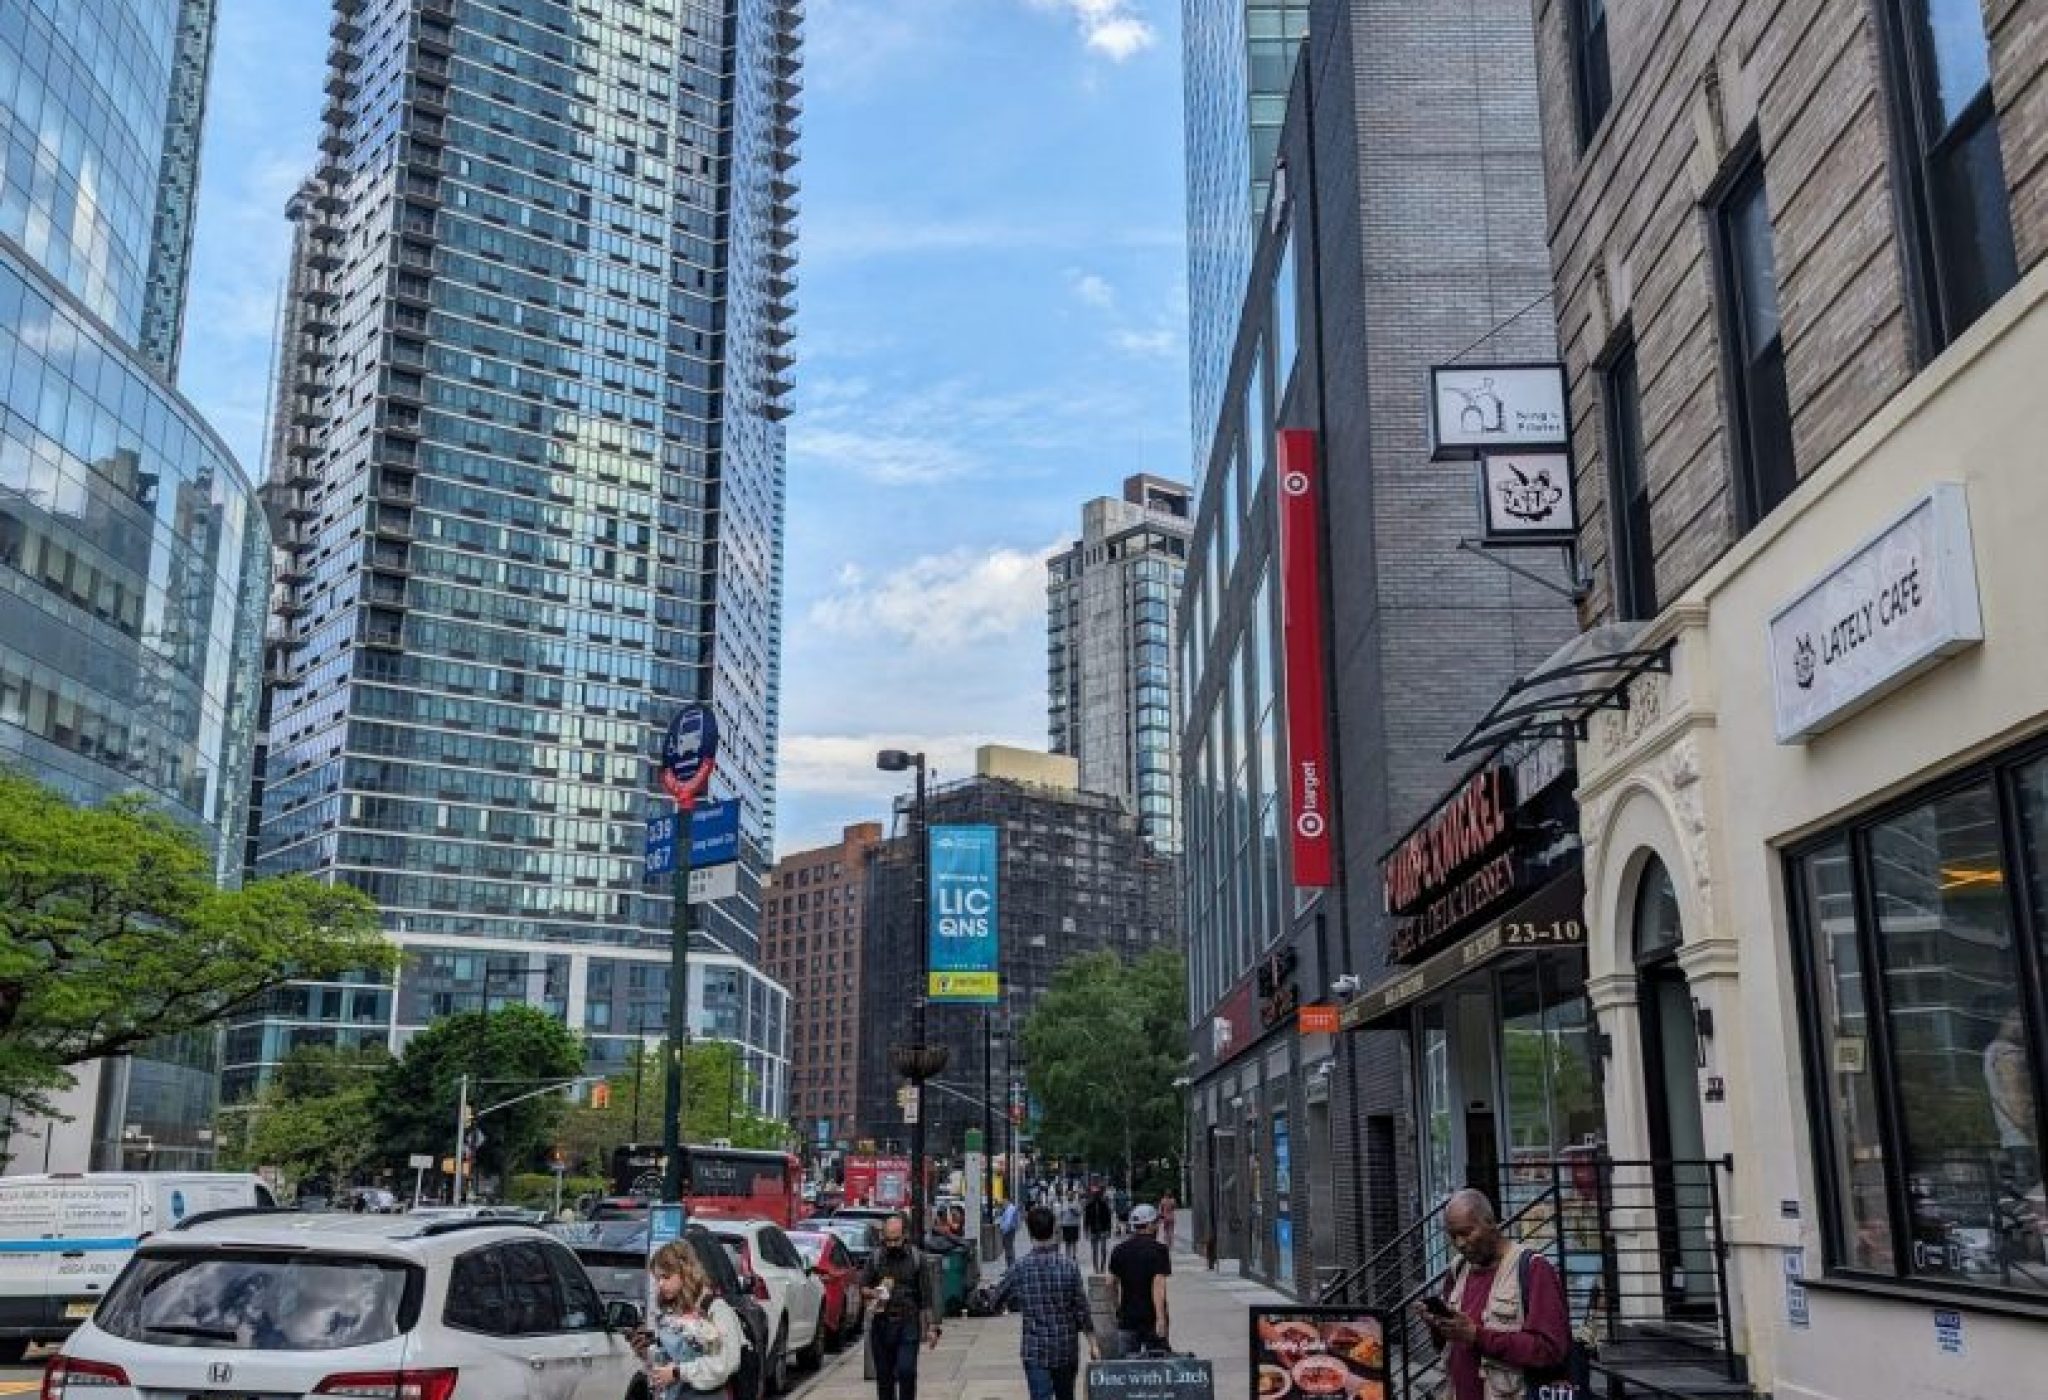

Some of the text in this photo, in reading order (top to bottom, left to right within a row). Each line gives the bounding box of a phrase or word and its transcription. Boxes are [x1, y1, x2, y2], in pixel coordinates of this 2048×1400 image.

[1821, 556, 1922, 665] LATELY CAFÉ
[1302, 761, 1320, 809] target
[939, 888, 991, 915] LIC
[939, 918, 989, 937] QNS
[1506, 921, 1581, 943] 23-10
